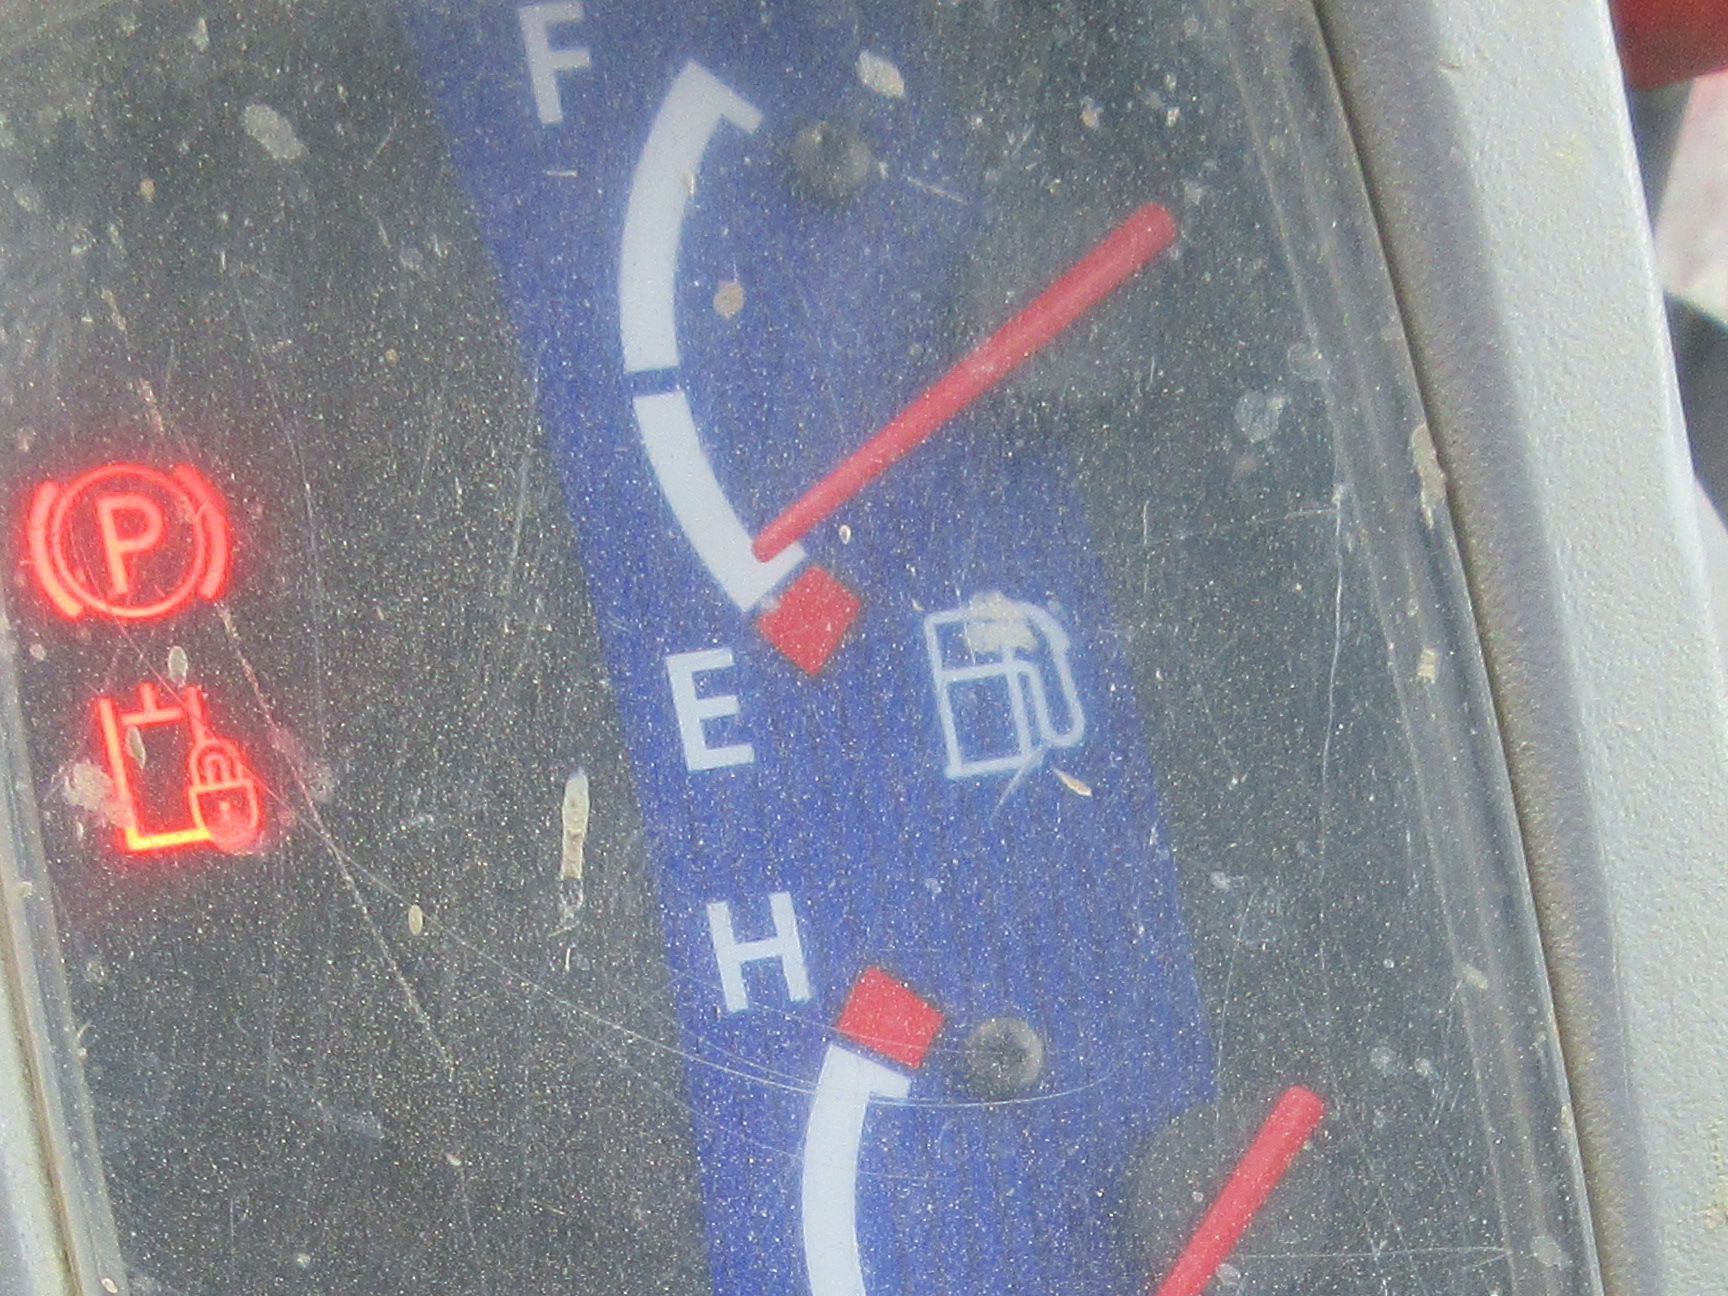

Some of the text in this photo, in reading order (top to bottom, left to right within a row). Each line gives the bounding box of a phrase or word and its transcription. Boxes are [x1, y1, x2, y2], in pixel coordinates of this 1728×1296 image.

[516, 3, 592, 125] F
[95, 492, 165, 596] P
[665, 647, 755, 772] E
[706, 891, 812, 1013] H
